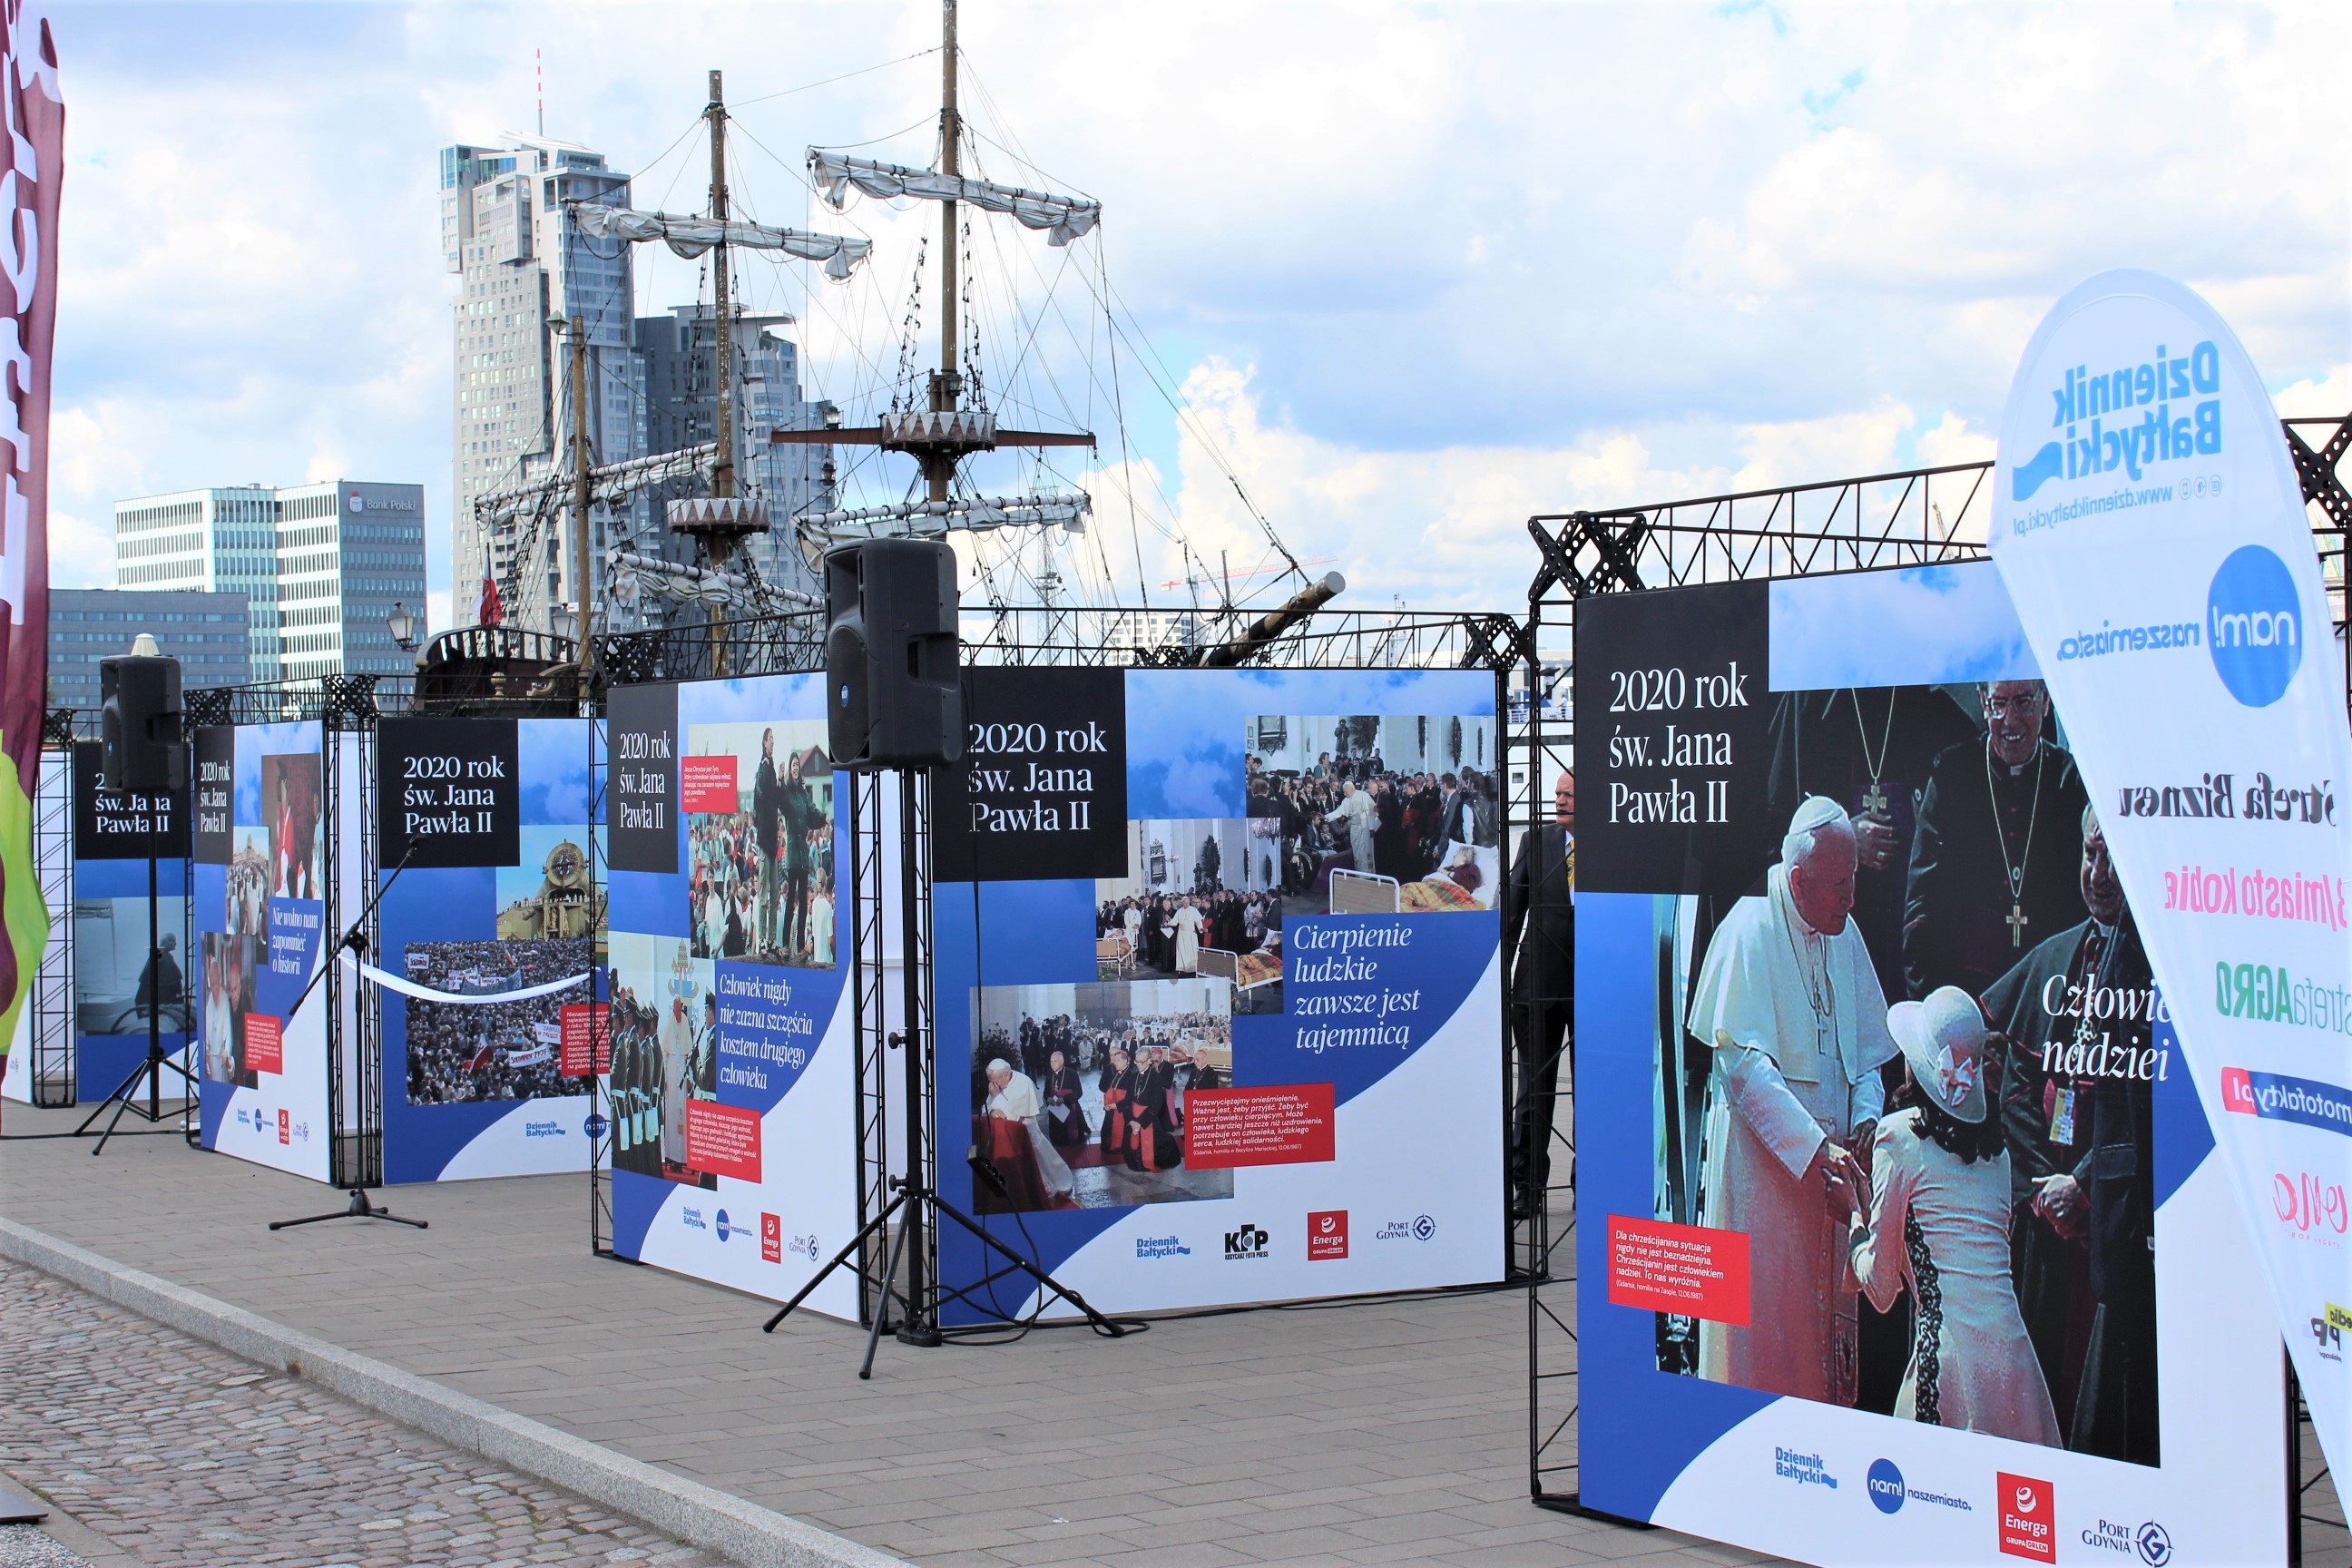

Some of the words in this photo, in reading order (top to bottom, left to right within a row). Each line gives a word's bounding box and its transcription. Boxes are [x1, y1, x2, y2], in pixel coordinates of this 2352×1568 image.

[367, 500, 387, 510] Bank
[390, 500, 416, 510] Polski
[1610, 668, 1685, 712] 2020
[1694, 662, 1749, 708] rok
[620, 733, 648, 759] 2020
[652, 730, 671, 759] rok
[967, 723, 1046, 753] 2020
[1055, 721, 1107, 752] rok
[1610, 725, 1652, 768] św.
[1661, 725, 1733, 767] Jana
[201, 762, 217, 781] 2020
[219, 760, 230, 781] rok
[404, 757, 461, 778] 2020
[467, 756, 505, 778] rok
[969, 761, 1014, 792] św.
[1024, 763, 1093, 791] Jana
[620, 767, 636, 793] św.
[639, 768, 665, 793] Jana
[96, 794, 123, 811] św.
[201, 787, 211, 807] św.
[211, 788, 226, 807] Jana
[405, 784, 437, 806] św.
[444, 785, 495, 806] Jana
[1609, 779, 1697, 823] Pawła
[1706, 780, 1729, 823] II
[96, 815, 149, 833] Pawła
[156, 816, 169, 832] II
[201, 812, 219, 833] Pawła
[220, 813, 225, 832] II
[405, 810, 471, 833] Pawła
[476, 812, 493, 832] II
[621, 801, 652, 828] Pawła
[655, 803, 663, 828] II
[969, 799, 1060, 832] Pawła
[1069, 801, 1090, 830] II
[272, 907, 283, 926] Nie
[283, 908, 303, 928] wolno
[303, 914, 318, 929] nam
[1294, 923, 1412, 954] Cierpienie
[278, 955, 300, 975] historii
[1295, 956, 1377, 983] ludzkie
[720, 974, 761, 997] Człowiek
[764, 979, 791, 1006] nigdy
[2043, 974, 2171, 1023] Człowie
[1294, 994, 1377, 1015] zawsze
[1377, 988, 1421, 1018] jest
[720, 1004, 734, 1024] nie
[736, 1010, 765, 1029] zazna
[767, 1011, 812, 1037] szczęścia
[1297, 1021, 1409, 1054] tajemnicą
[720, 1031, 759, 1057] kosztem
[760, 1037, 805, 1069] drugiego
[2043, 1033, 2169, 1082] nadziei
[720, 1063, 767, 1089] człowieka
[1192, 1099, 1250, 1107] Przezwyciężajmy
[1251, 1095, 1298, 1103] onieśmielenie.
[1217, 1106, 1230, 1114] jest,
[1233, 1104, 1249, 1114] żeby
[1250, 1103, 1276, 1112] przyjść.
[1279, 1102, 1294, 1111] Żeby
[1297, 1102, 1308, 1110] być
[526, 1121, 557, 1130] Dziennik
[1193, 1116, 1207, 1124] przy
[1210, 1112, 1246, 1122] człowieku
[1245, 1112, 1283, 1122] cierpiącym.
[1193, 1123, 1214, 1132] nawet
[1216, 1122, 1242, 1130] bardziej
[1282, 1117, 1322, 1125] uzdrowienia,
[526, 1127, 555, 1137] Bałtycki
[1193, 1130, 1230, 1140] potrzebuje
[1242, 1128, 1275, 1136] człowieka,
[1278, 1126, 1308, 1134] ludzkiego
[1216, 1138, 1240, 1146] ludzkiej
[1243, 1135, 1284, 1144] solidarności.
[1377, 1230, 1409, 1240] GDYNIA
[1388, 1222, 1409, 1230] PORT
[763, 1236, 779, 1249] Energa
[795, 1235, 806, 1247] PORT
[1137, 1236, 1179, 1248] Dziennik
[1137, 1246, 1176, 1259] Bałtycki
[1313, 1236, 1343, 1246] Energa
[1616, 1230, 1626, 1240] Dla
[1629, 1233, 1679, 1249] chrześcijanina
[1681, 1240, 1710, 1254] sytuacja
[1616, 1243, 1634, 1254] nigdy
[1637, 1247, 1646, 1255] nie
[1649, 1248, 1661, 1259] jest
[1664, 1250, 1712, 1266] beznadziejna.
[1616, 1253, 1662, 1269] Chrześcijanin
[1663, 1261, 1677, 1272] jest
[1680, 1264, 1724, 1279] człowiekiem
[1616, 1266, 1642, 1279] nadziei.
[1645, 1269, 1651, 1279] To
[1654, 1274, 1666, 1282] nas
[1669, 1275, 1701, 1289] wyróżnia.
[1775, 1446, 1823, 1470] Dziennik
[1776, 1461, 1819, 1484] Bałtycki
[1870, 1478, 1903, 1497] nam!
[1907, 1488, 1972, 1511] naszemiasto.
[2005, 1514, 2048, 1537] Energa
[2099, 1519, 2131, 1539] PORT
[2006, 1536, 2025, 1547] GRUPA
[2027, 1542, 2047, 1552] ORLEN
[2082, 1530, 2131, 1553] GDYNIA
